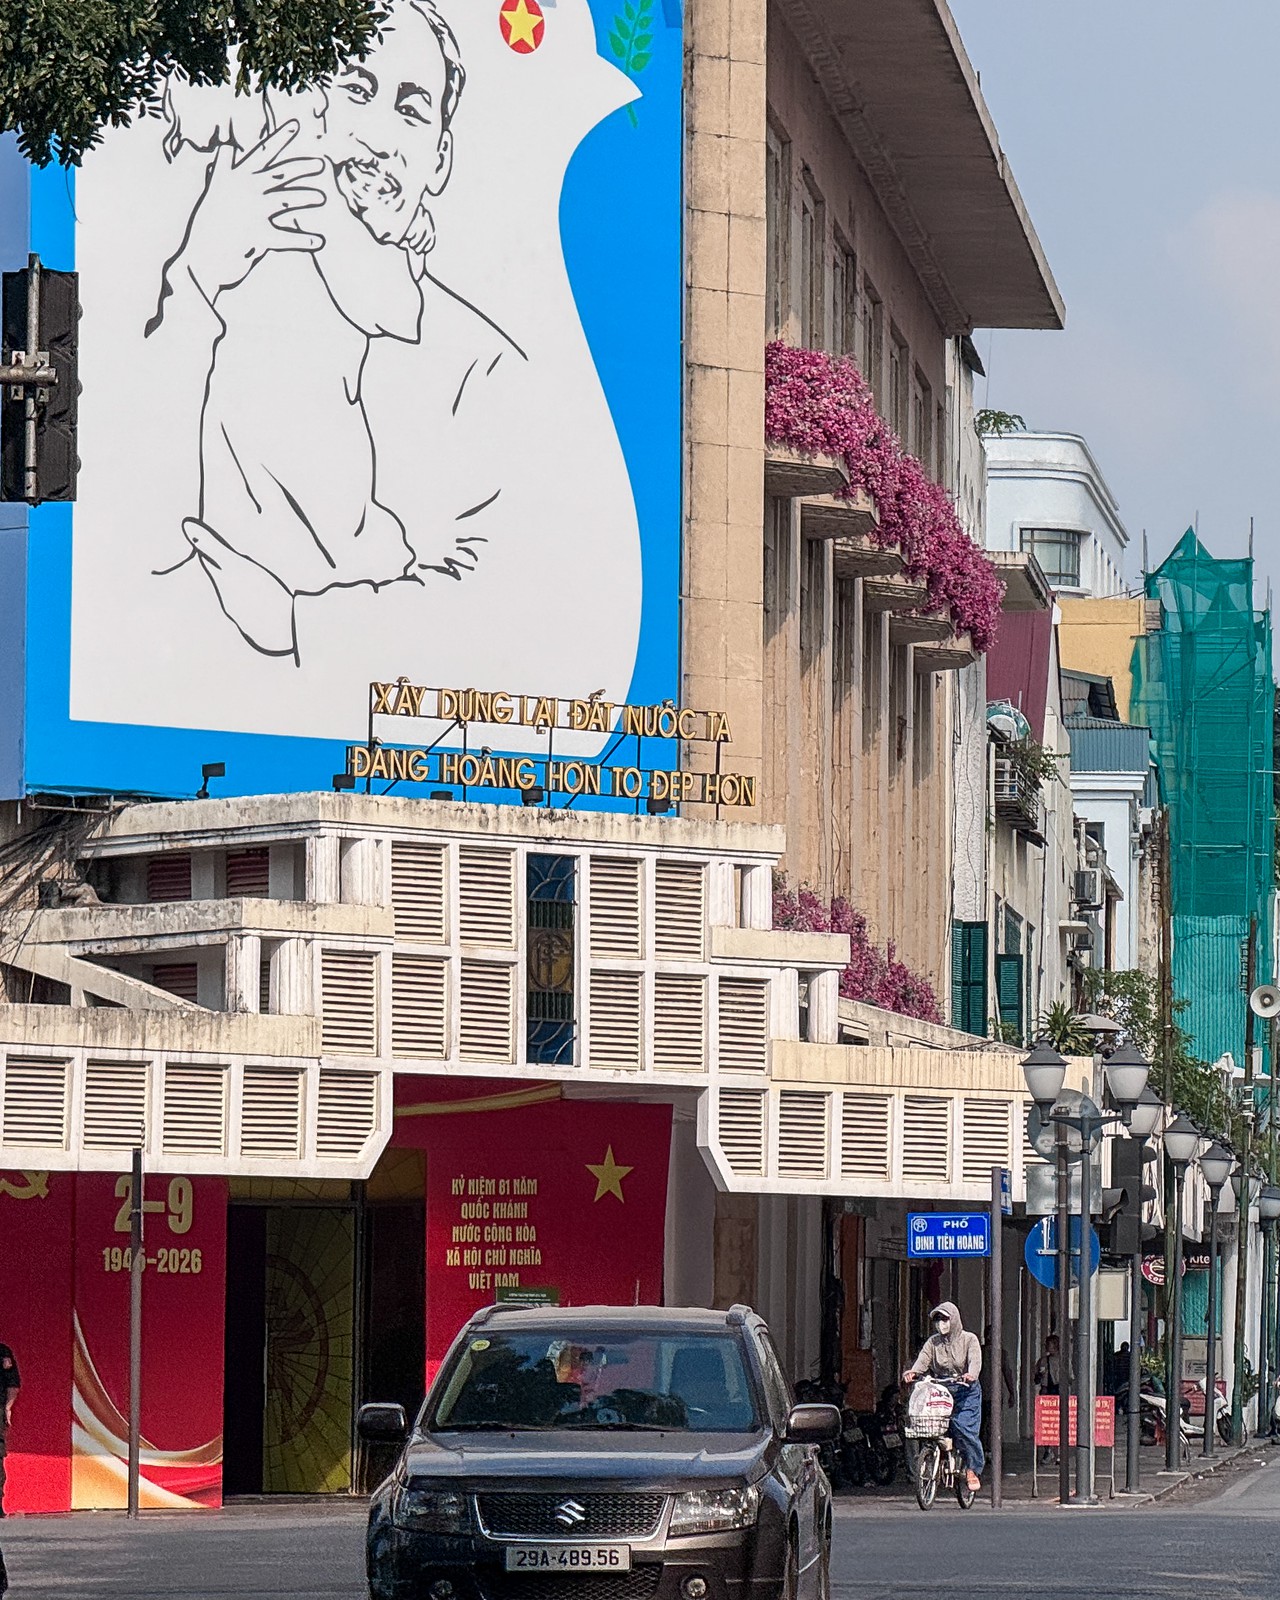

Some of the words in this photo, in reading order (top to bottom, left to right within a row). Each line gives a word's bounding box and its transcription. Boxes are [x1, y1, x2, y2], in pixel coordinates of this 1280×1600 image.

[372, 676, 426, 716] XÂY
[438, 688, 513, 728] DỰNG
[519, 695, 559, 734] LẠI
[567, 688, 614, 731] ĐẤT
[623, 699, 696, 740] NƯỚC
[706, 711, 733, 742] TA
[351, 737, 430, 782] ĐÀNG
[439, 746, 537, 791] HOÀNG
[545, 761, 601, 795] HƠN
[612, 767, 643, 798] TO
[702, 773, 756, 807] HƠN
[114, 1174, 193, 1234] 2-9
[943, 1216, 969, 1229] PHỐ
[937, 1232, 955, 1250] TIÊN
[957, 1232, 984, 1250] HOÀNG
[446, 1246, 460, 1266] XÃ
[494, 1273, 520, 1287] NAM
[516, 1549, 620, 1567] 29A-489.56
